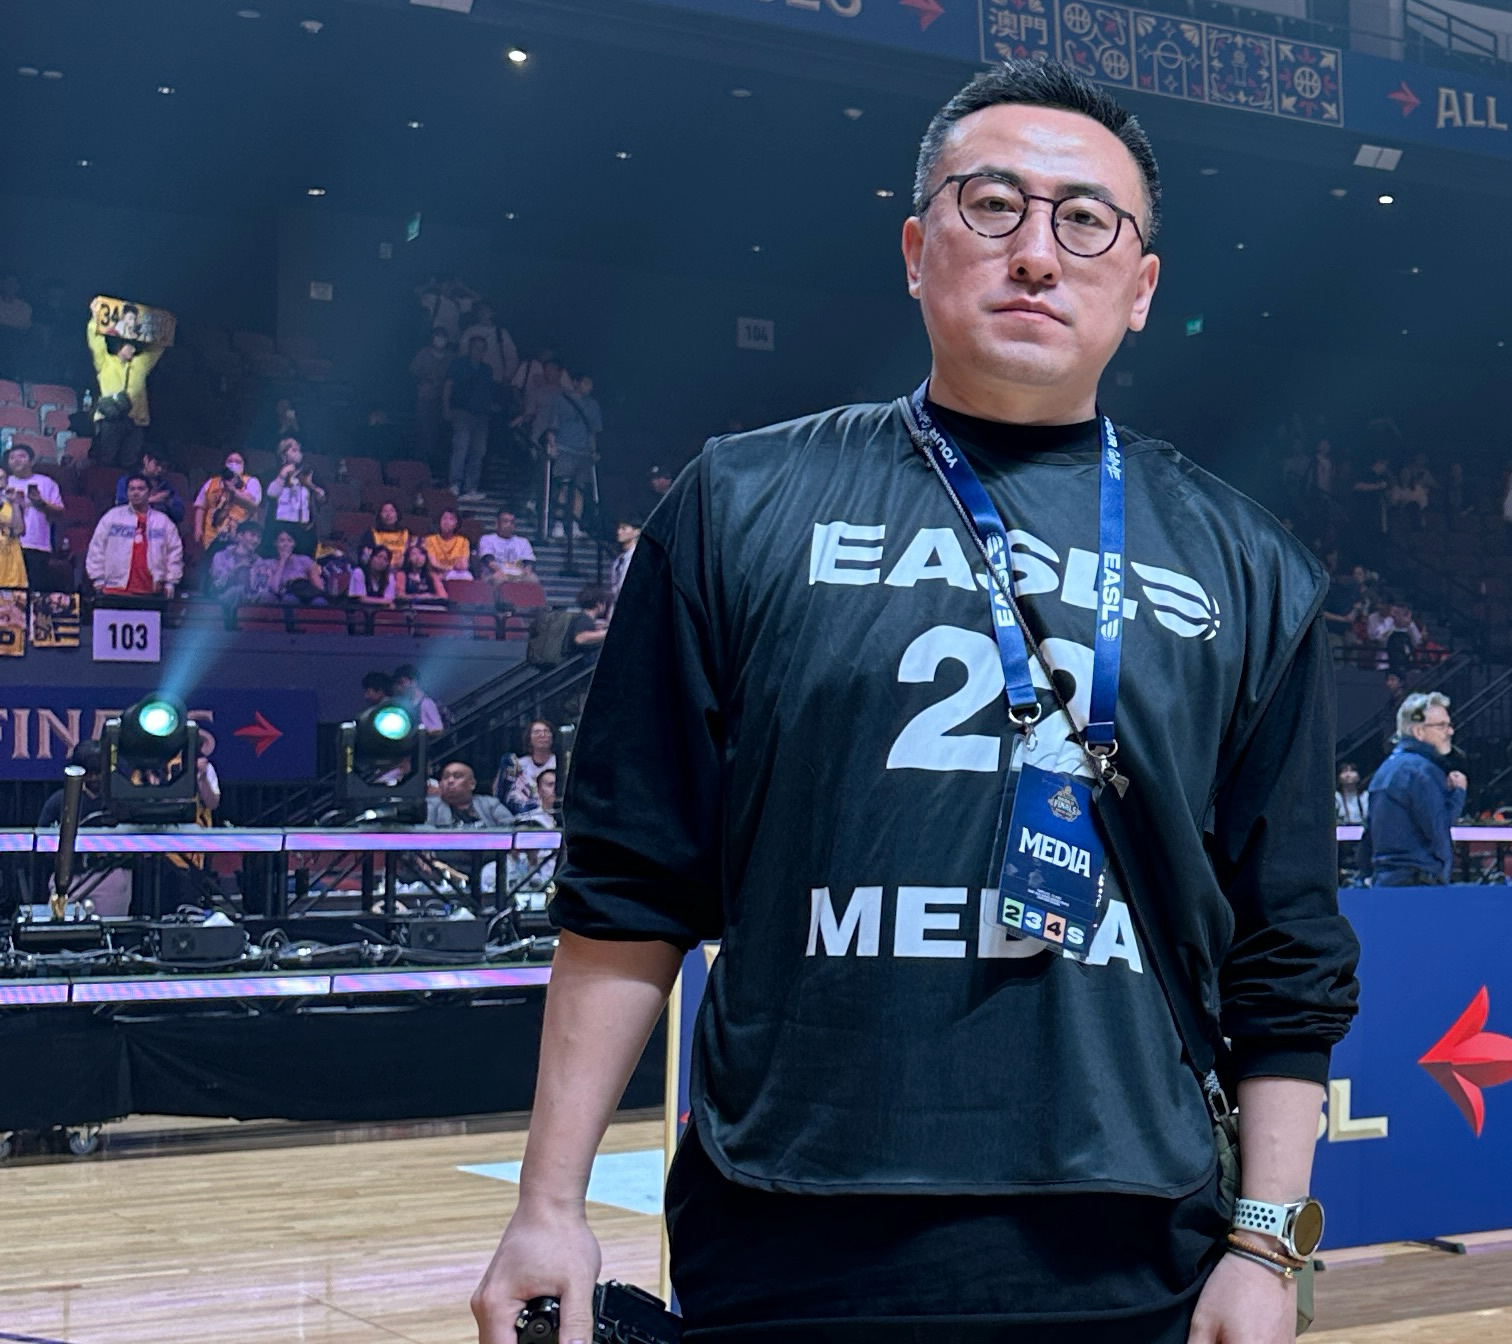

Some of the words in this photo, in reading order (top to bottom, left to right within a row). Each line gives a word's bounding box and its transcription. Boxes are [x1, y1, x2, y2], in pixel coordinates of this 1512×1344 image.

[988, 9, 1048, 45] 澳門
[1436, 87, 1508, 131] ALL
[101, 303, 120, 325] 34
[929, 427, 958, 469] YOUR
[808, 521, 1138, 622] EASL
[1103, 552, 1121, 620] EASL
[108, 623, 148, 650] 103
[886, 625, 1097, 778] 22
[1018, 826, 1091, 878] MEDIA
[1005, 904, 1020, 922] 2
[1025, 911, 1042, 930] 3
[1047, 921, 1061, 937] 4
[1066, 926, 1085, 945] S
